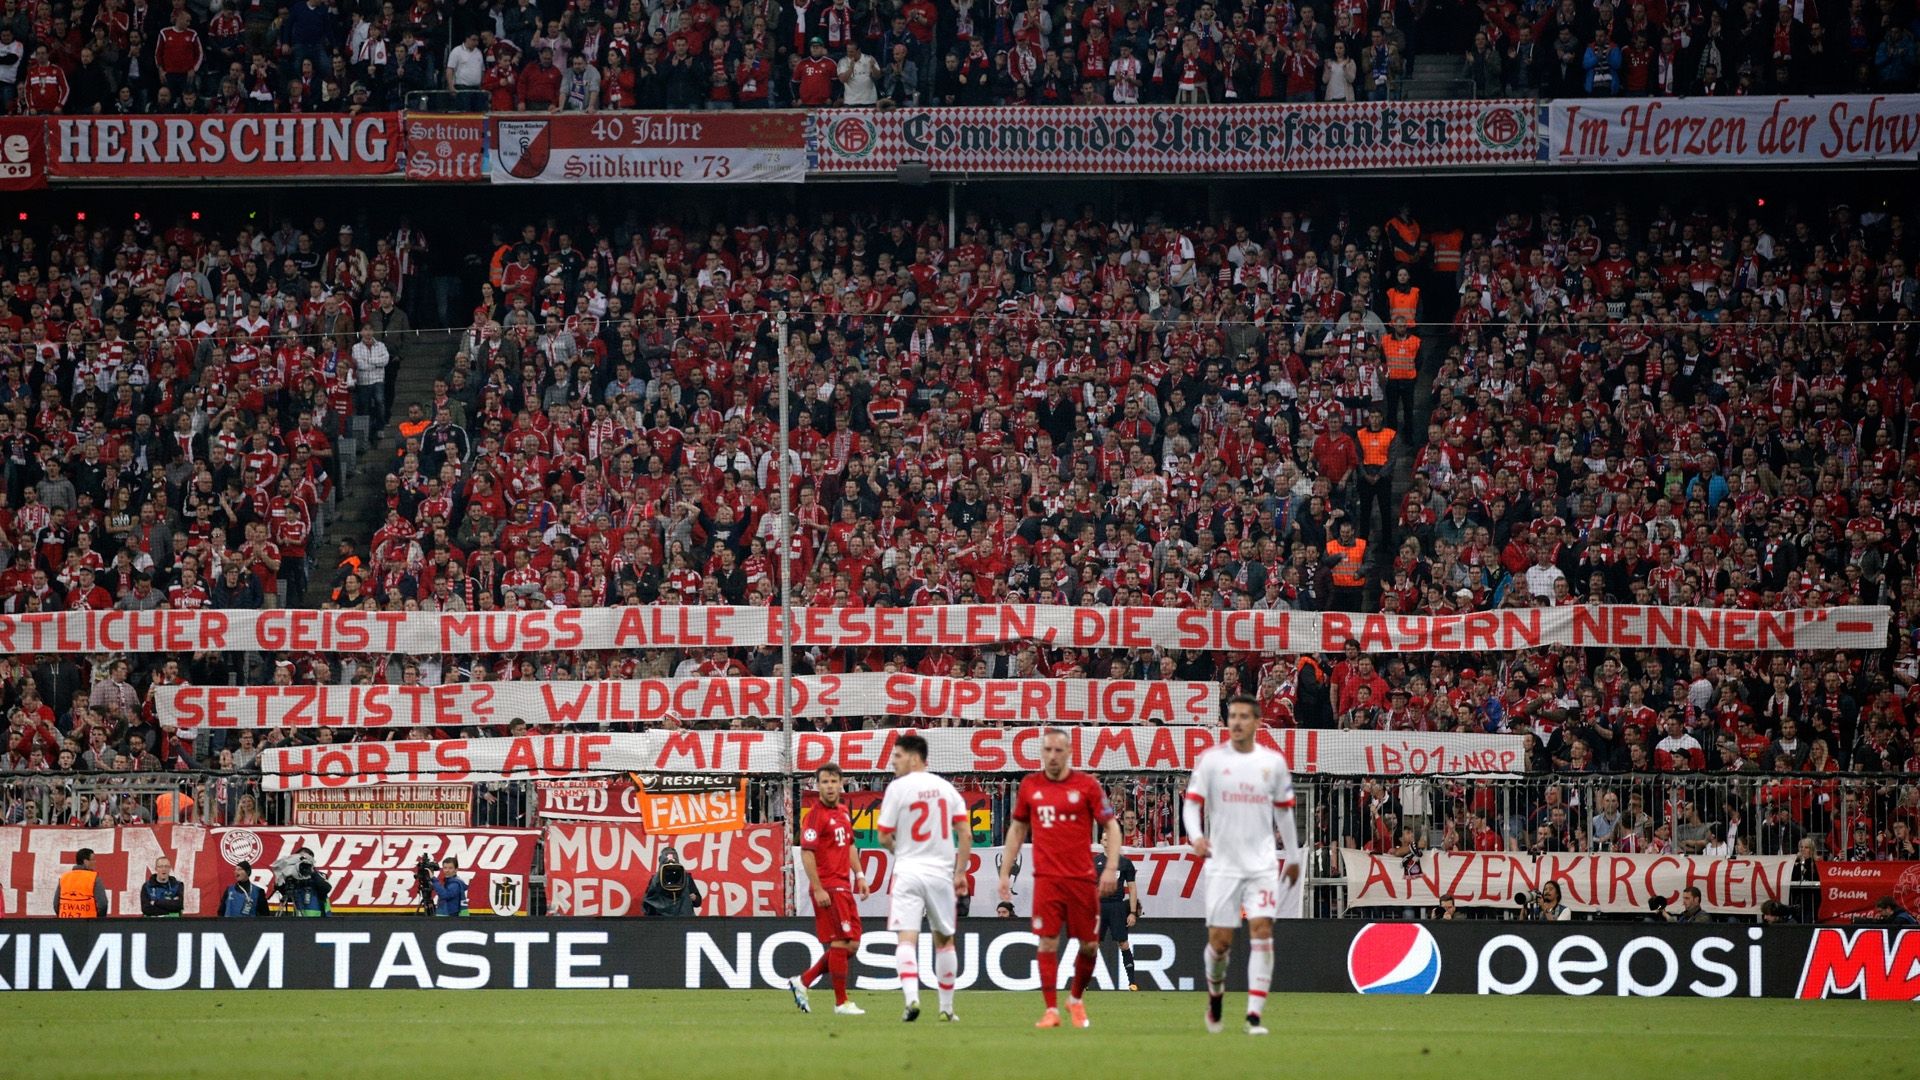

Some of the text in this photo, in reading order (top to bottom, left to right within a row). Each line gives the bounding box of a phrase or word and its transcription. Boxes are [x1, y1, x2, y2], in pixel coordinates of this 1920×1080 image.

[0, 132, 30, 163] e
[58, 117, 388, 164] HERRSCHING
[408, 121, 480, 141] Sektion
[591, 115, 703, 145] 40 Jahre
[902, 106, 1449, 163] Commando Unterfranken
[1558, 105, 1610, 157] Im
[1616, 101, 1748, 158] Herzen
[1756, 98, 1817, 156] der
[408, 150, 480, 178] Suff
[563, 153, 732, 180] Südkurve '73
[256, 610, 408, 651] GEIST
[440, 609, 584, 652] MUSS
[615, 606, 735, 646] ALLE
[767, 605, 1058, 646] BESEELEN,
[1073, 607, 1154, 647] DIE
[1177, 609, 1290, 651] SICH
[1320, 609, 1542, 652] BAYERN
[173, 672, 1209, 728] SETZLISTE? WILDCARD? SUPERLIGA?
[501, 734, 612, 778] AUF
[655, 730, 764, 770] MIT
[400, 787, 411, 802] SO
[545, 786, 641, 814] RED G
[651, 789, 737, 828] FANS!
[909, 798, 948, 842] 21
[549, 876, 632, 917] RED
[1258, 889, 1277, 908] 34
[1355, 850, 1789, 908] ANZENKIRCHEN
[60, 902, 91, 912] EWARD
[0, 931, 285, 990] IMUM
[314, 930, 630, 990] TASTE.
[685, 930, 818, 990] NO
[1477, 927, 1763, 997] pepsi
